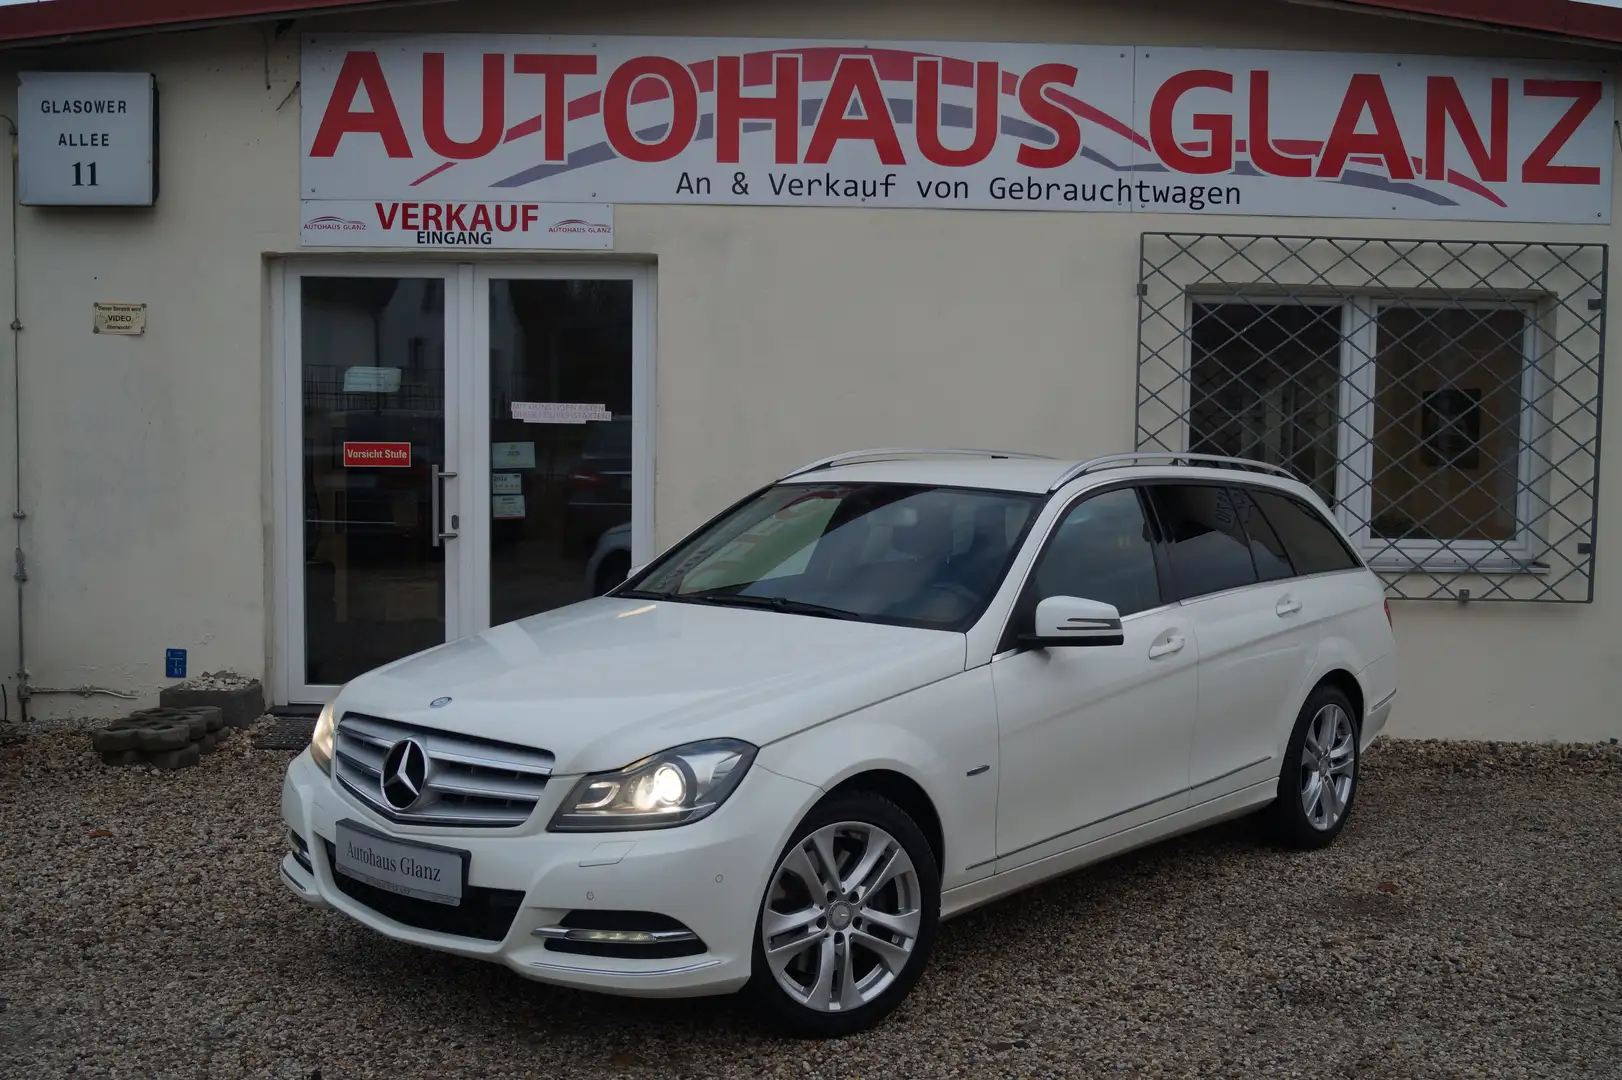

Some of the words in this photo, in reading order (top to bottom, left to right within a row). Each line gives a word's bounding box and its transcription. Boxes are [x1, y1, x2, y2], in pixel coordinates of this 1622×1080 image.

[40, 100, 127, 114] GLASOWER
[309, 50, 1081, 169] AUTOHAUS
[1149, 68, 1602, 185] GLANZ
[58, 133, 110, 147] ALLEE
[71, 161, 99, 187] 11
[675, 172, 712, 195] An
[732, 171, 750, 196] &
[768, 172, 897, 198] Verkauf
[917, 179, 970, 199] von
[989, 176, 1241, 210] Gebrauchtwagen
[375, 202, 539, 232] VERKAUF
[416, 231, 493, 245] EINGANG
[107, 314, 132, 322] VIDEO
[346, 448, 383, 459] Vorsicht
[384, 448, 408, 459] Stufe
[346, 840, 397, 873] Autohaus
[399, 856, 442, 882] Glanz
